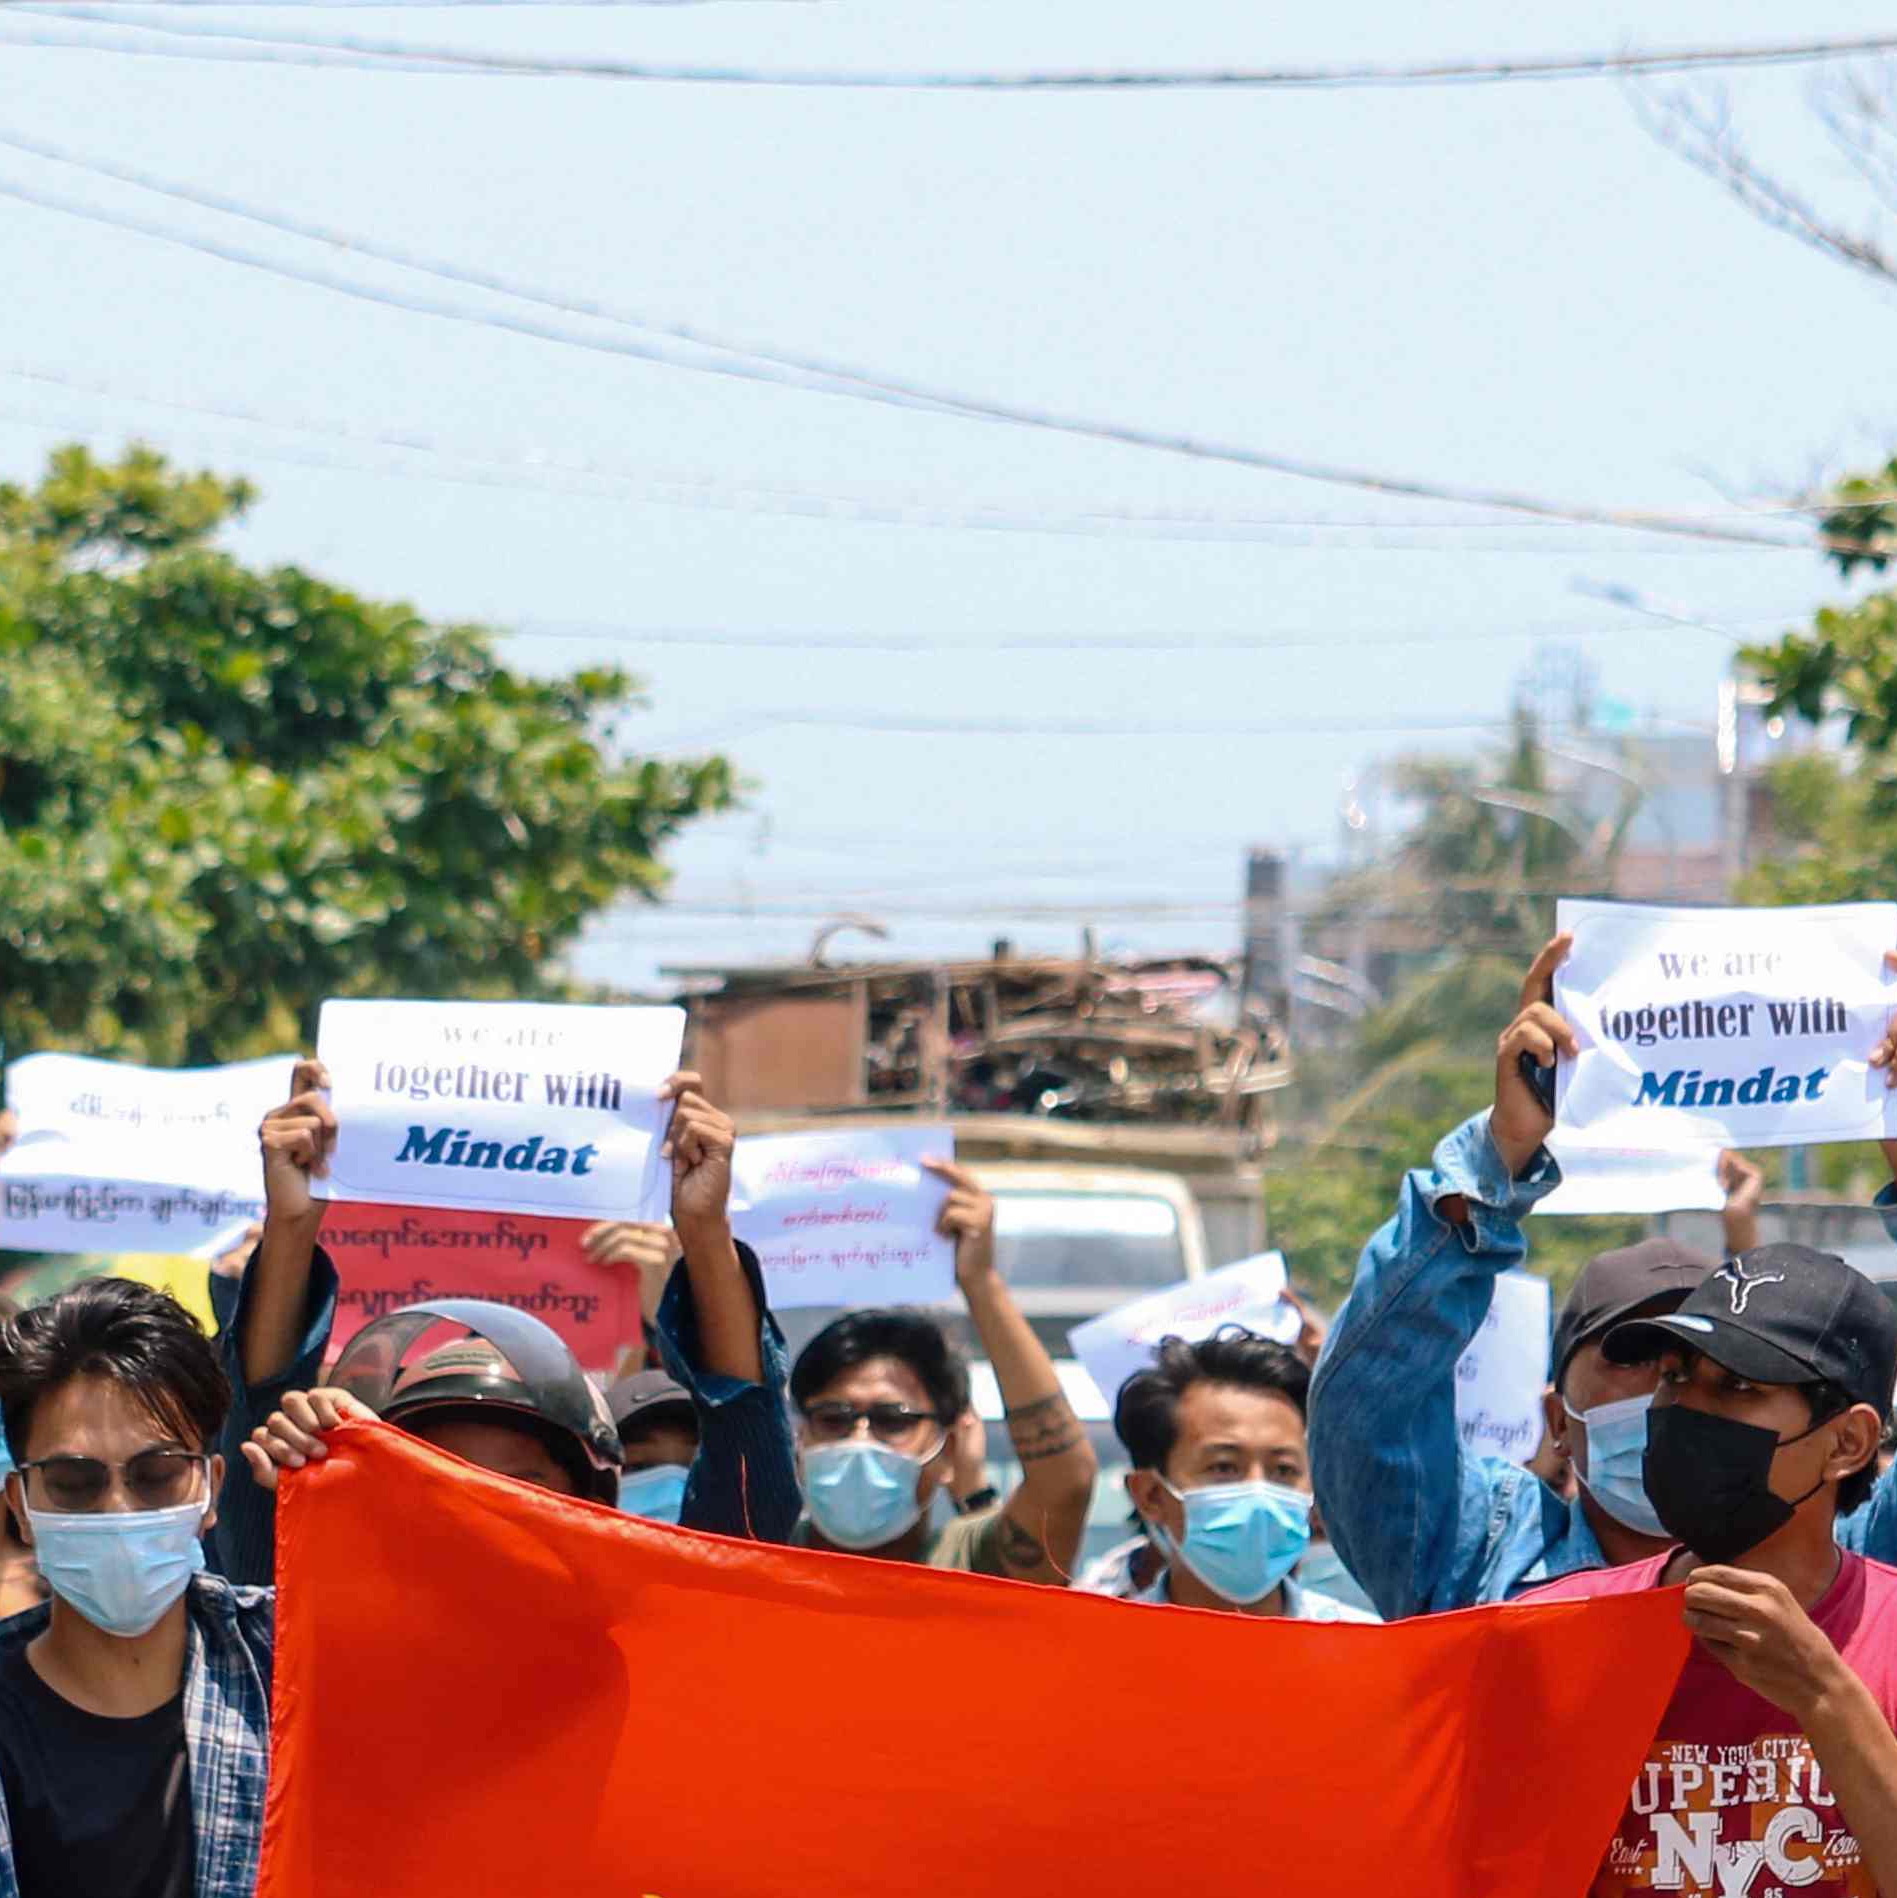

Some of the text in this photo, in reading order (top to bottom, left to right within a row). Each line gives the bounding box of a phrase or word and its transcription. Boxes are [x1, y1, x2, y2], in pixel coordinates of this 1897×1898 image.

[1600, 997, 1847, 1047] together with
[374, 1061, 621, 1111] together with
[1632, 1066, 1829, 1108] Mindat
[395, 1125, 599, 1176] Mindat
[1631, 1756, 1836, 1814] UPERIO
[1609, 1838, 1648, 1864] East
